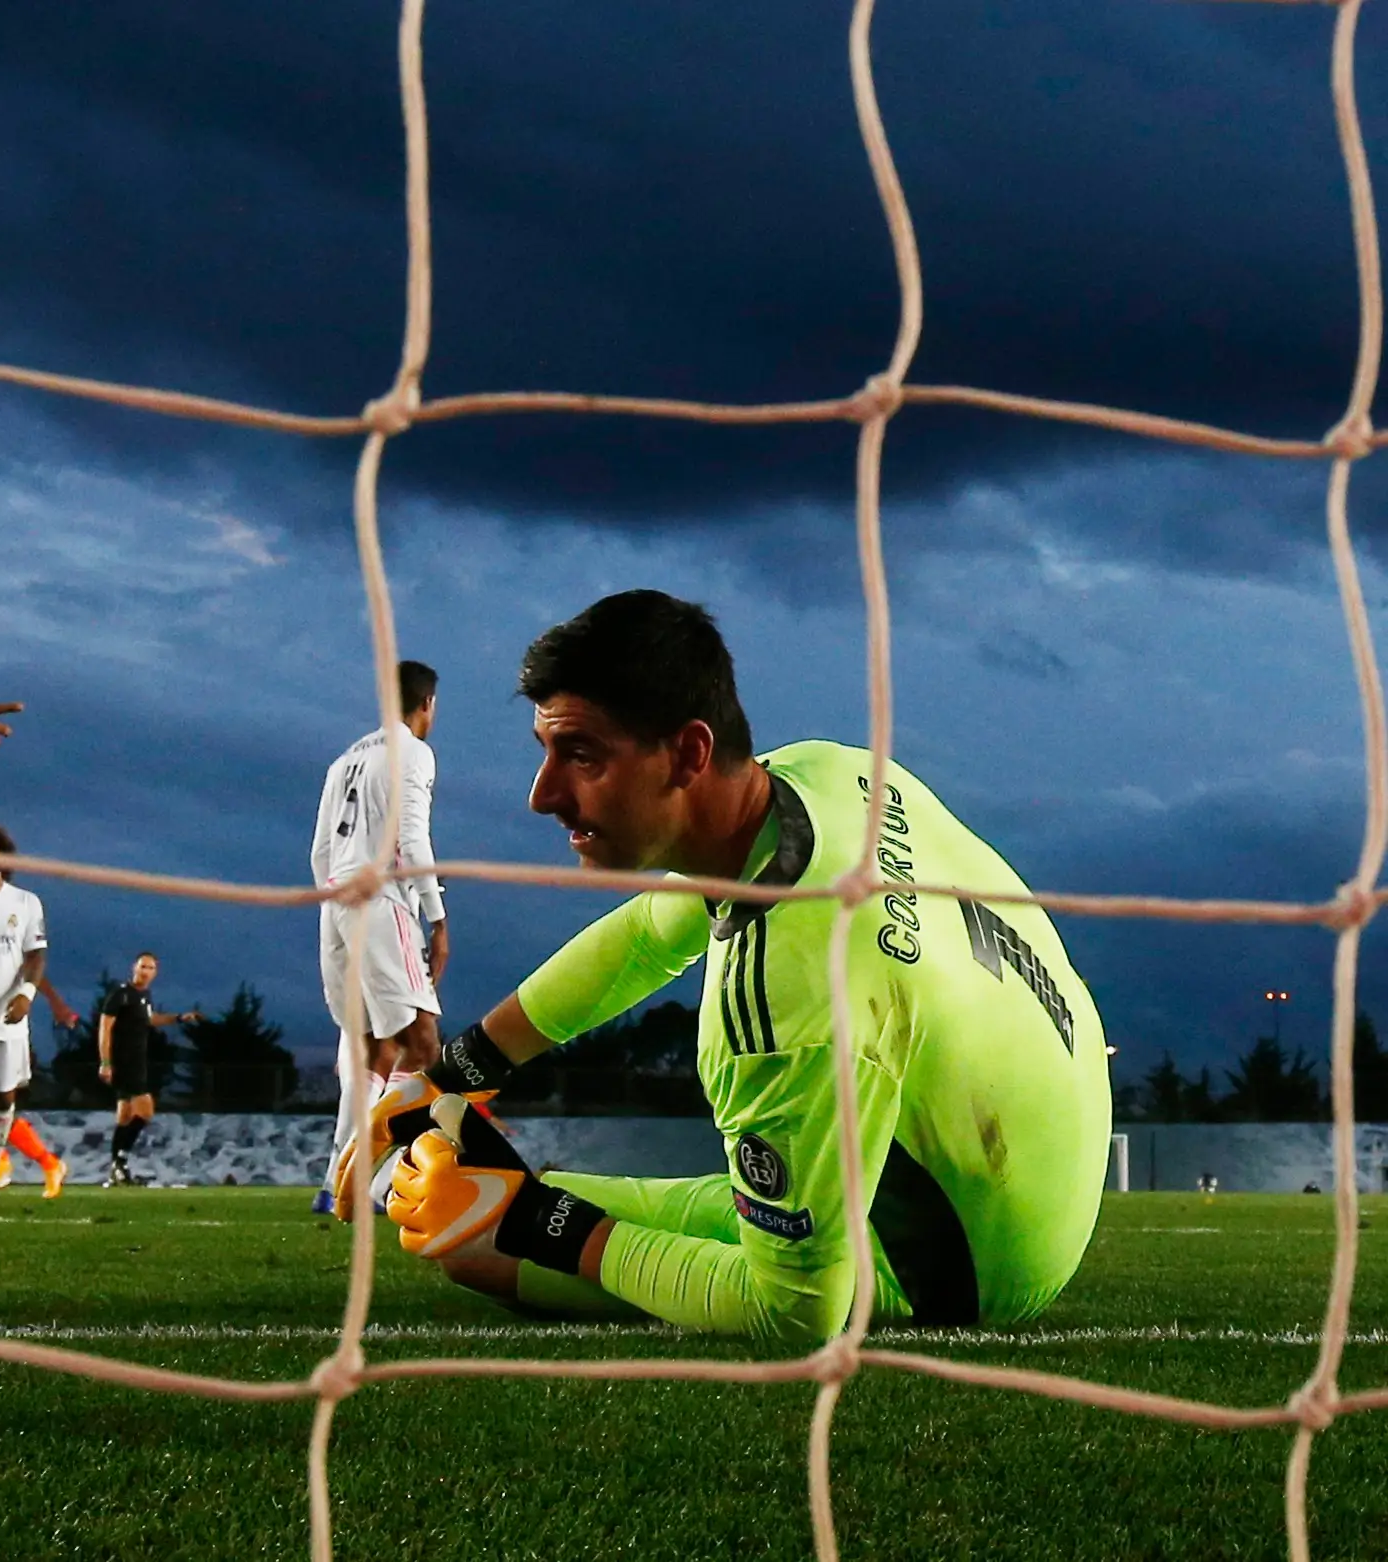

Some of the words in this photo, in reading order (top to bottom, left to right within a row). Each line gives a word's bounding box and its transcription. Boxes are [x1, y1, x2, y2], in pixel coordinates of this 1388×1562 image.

[953, 887, 1074, 1059] 1
[751, 1166, 772, 1185] 13
[749, 1206, 809, 1233] RESPECT
